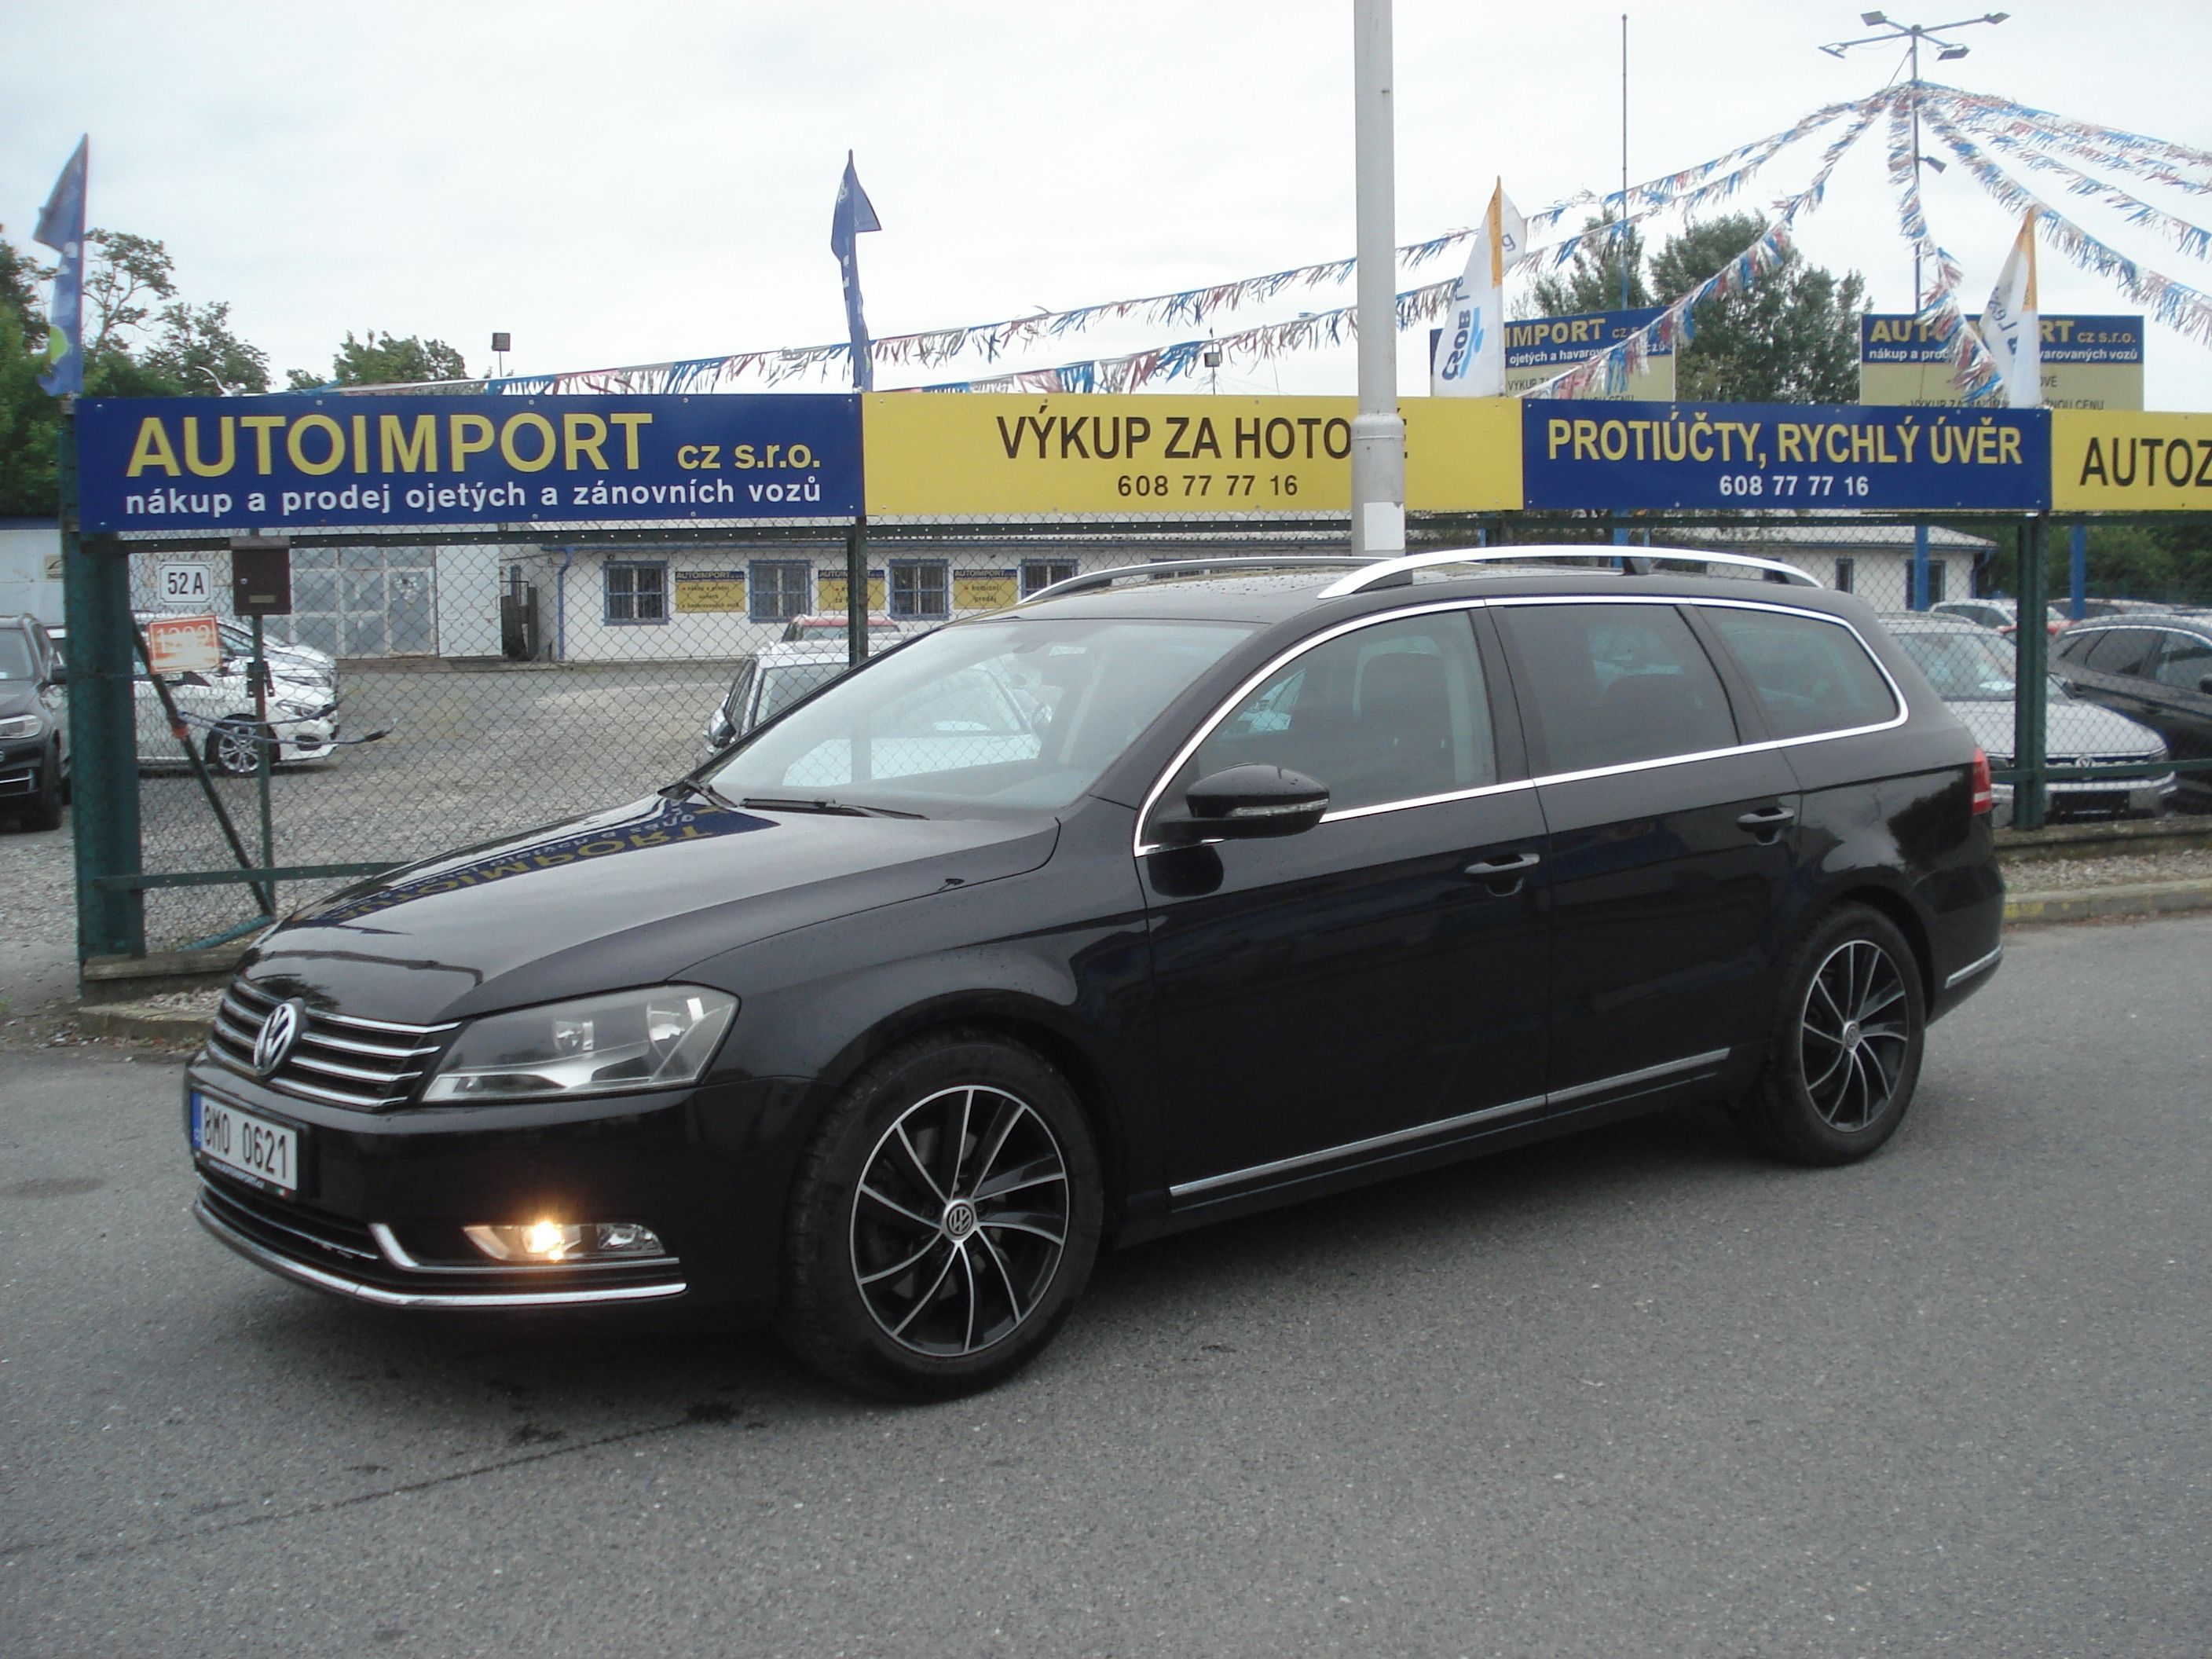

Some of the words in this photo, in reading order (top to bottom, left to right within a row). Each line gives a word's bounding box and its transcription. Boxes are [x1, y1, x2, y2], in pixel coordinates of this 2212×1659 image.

[1505, 318, 1606, 348] IMPORT
[1612, 328, 1628, 339] cz
[2077, 331, 2094, 343] cz
[2099, 331, 2136, 343] s.r.o.
[1510, 351, 1547, 366] ojetých
[1550, 352, 1557, 361] a
[1559, 347, 1606, 361] havarov
[1869, 348, 1907, 361] nákup
[1910, 350, 1918, 359] a
[2041, 349, 2107, 362] varovaných
[126, 412, 653, 478] AUTOIMPORT
[676, 444, 720, 470] cz
[734, 443, 821, 470] s.r.o.
[996, 405, 1151, 460] VÝKUP
[1164, 417, 1221, 460] ZA
[1236, 408, 1408, 460] HOTO
[1547, 412, 1767, 470] PROTIÚČTY,
[1778, 415, 1920, 464] RYCHLÝ
[1930, 416, 2023, 465] ÚVĚR
[2079, 437, 2212, 488] AUTOZ
[126, 488, 233, 518] nákup
[247, 492, 266, 513] a
[282, 483, 390, 516] prodej
[405, 482, 526, 513] ojetých
[540, 485, 558, 506] a
[573, 478, 734, 506] zánovních
[748, 476, 821, 504] vozů
[1118, 474, 1169, 496] 608
[1183, 474, 1212, 496] 77
[1226, 474, 1256, 496] 77
[1269, 474, 1298, 496] 16
[1719, 474, 1763, 496] 608
[1772, 475, 1798, 496] 77
[1808, 475, 1834, 496] 77
[1844, 476, 1870, 496] 16
[168, 572, 189, 595] 52
[192, 572, 204, 595] A
[243, 1122, 286, 1180] 0621
